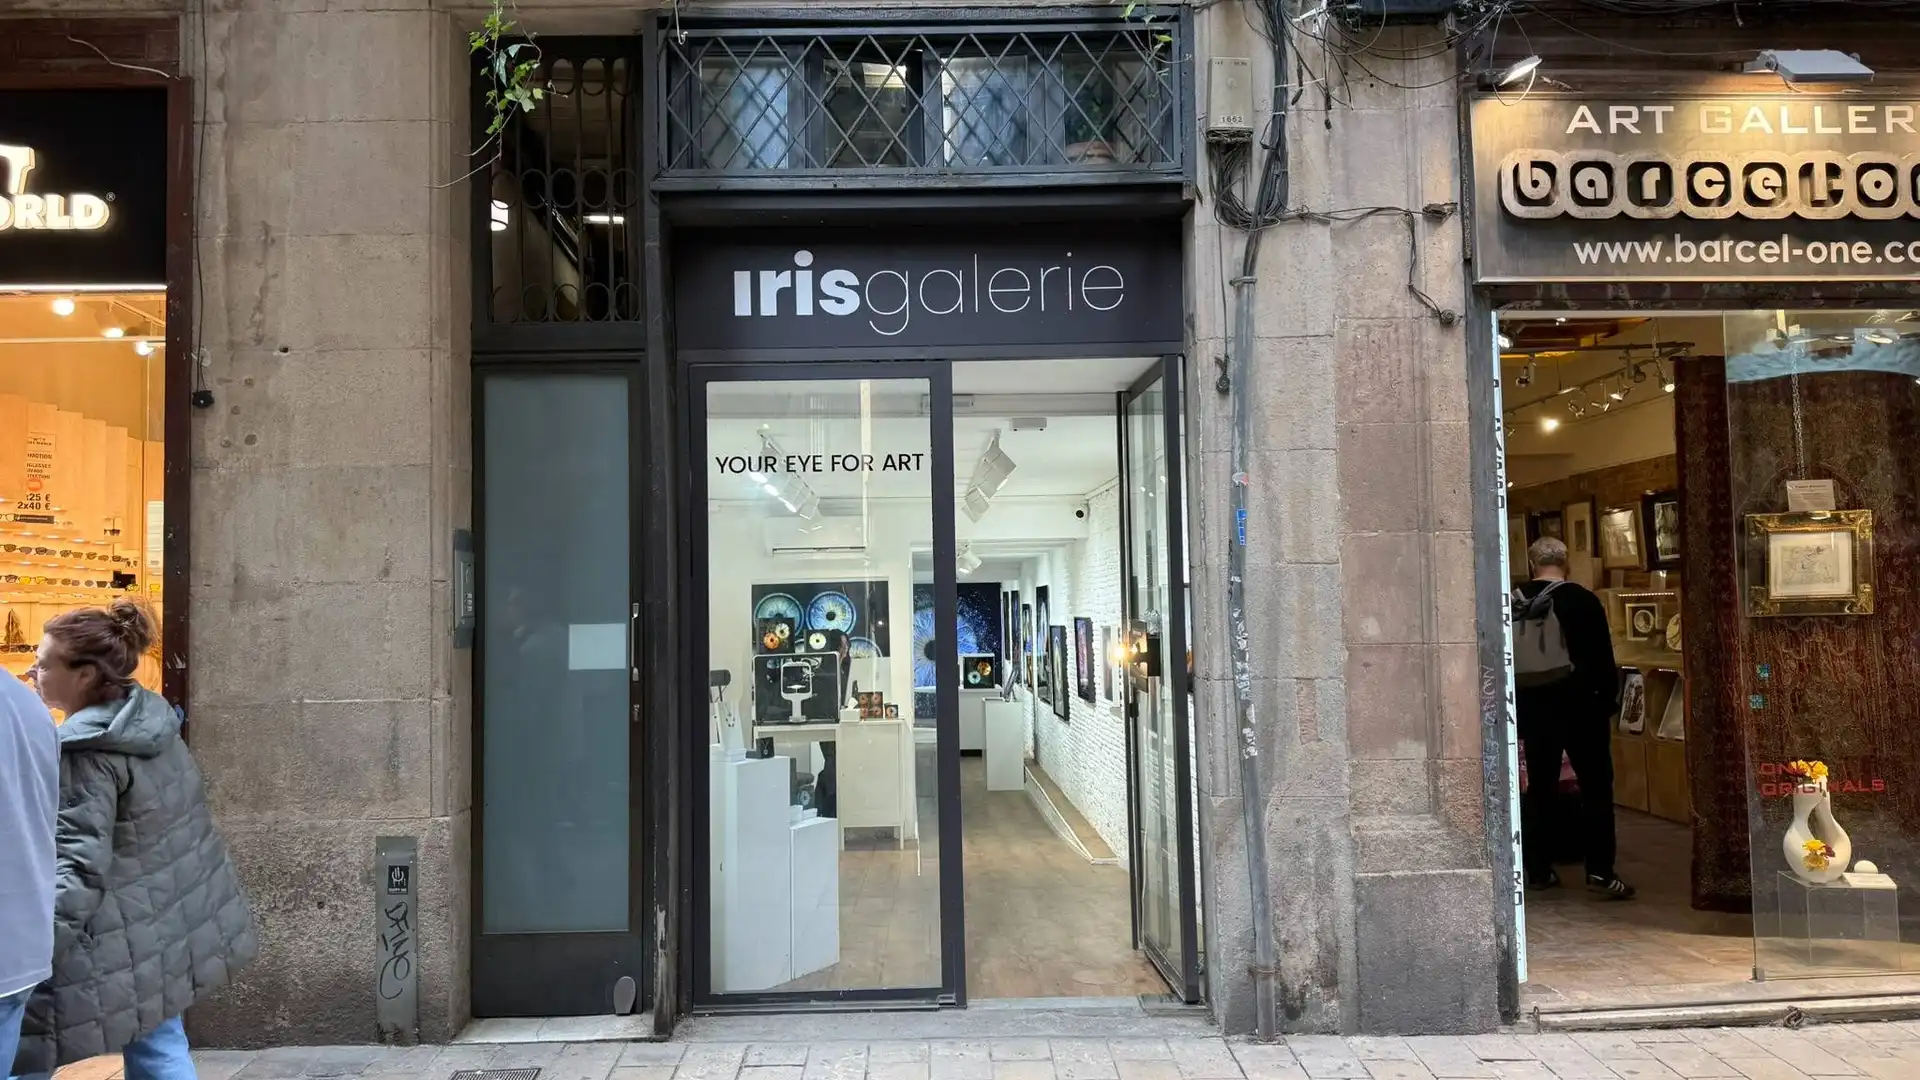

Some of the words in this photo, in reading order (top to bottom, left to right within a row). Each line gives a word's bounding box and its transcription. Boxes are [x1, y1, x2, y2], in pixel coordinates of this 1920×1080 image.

[1566, 105, 1675, 134] ART
[1700, 105, 1920, 134] GALLER
[715, 456, 777, 474] YOUR
[786, 455, 822, 473] EYE
[831, 454, 874, 473] FOR
[882, 453, 924, 472] ART
